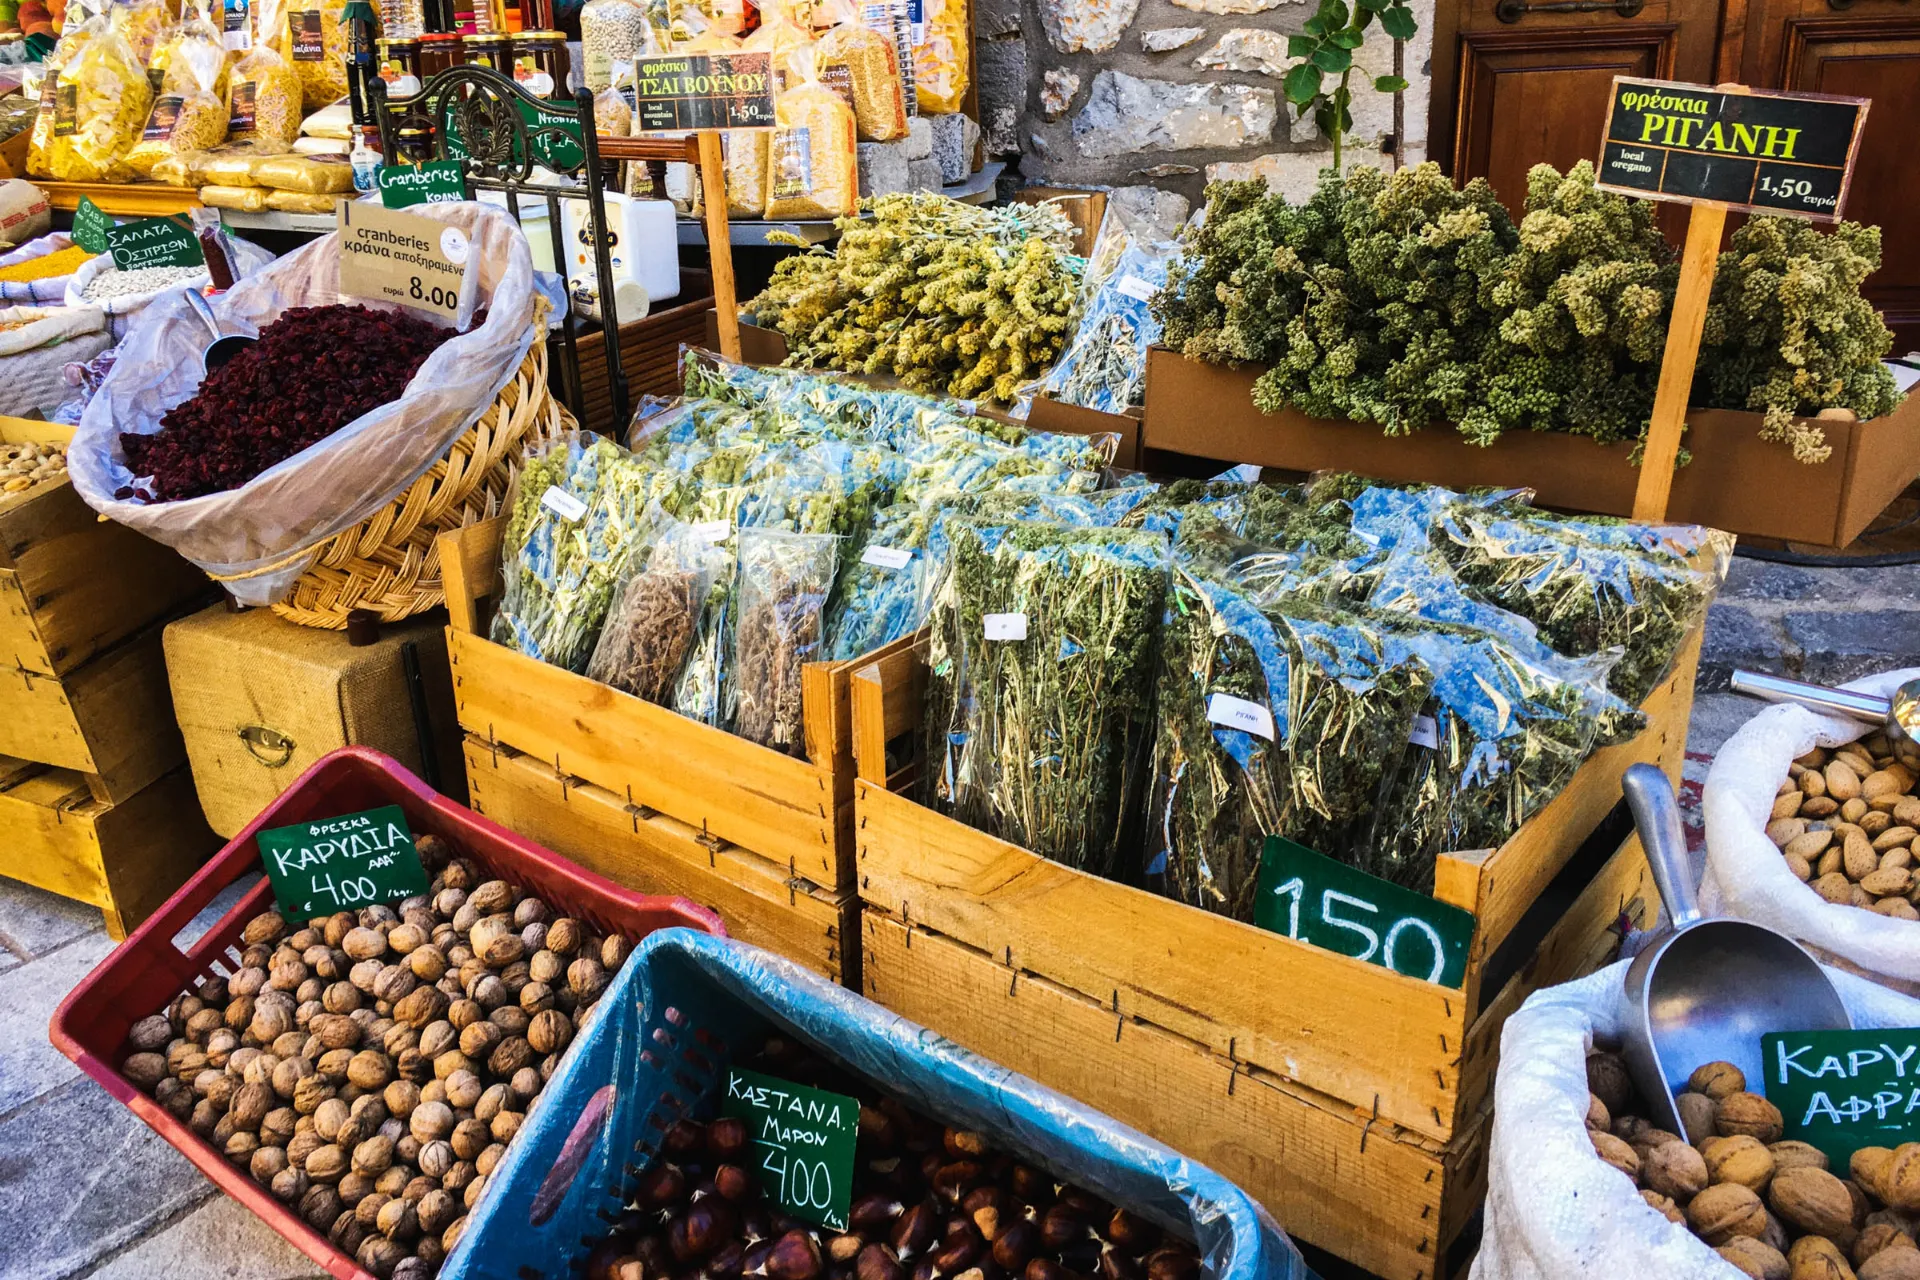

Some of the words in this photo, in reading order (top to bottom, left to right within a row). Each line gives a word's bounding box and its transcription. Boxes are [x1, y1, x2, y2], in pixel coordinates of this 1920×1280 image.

[642, 60, 688, 76] φρέσκο
[639, 77, 680, 95] ΤΣΑΙ
[684, 74, 767, 94] ΒΟΥΝΟΥ
[1621, 89, 1708, 114] φρέσκια
[1639, 113, 1801, 158] ΡΙΓΑΝΗ
[1611, 159, 1651, 173] oregano
[1621, 149, 1644, 161] local
[379, 165, 458, 188] Cranberies
[1760, 176, 1812, 198] 1,50
[1803, 194, 1836, 207] ευρώ
[106, 224, 173, 247] ΣΑΛΑΤΑ
[357, 227, 430, 252] cranberies
[344, 239, 390, 258] κράνα
[409, 276, 458, 310] 8.00
[309, 816, 371, 837] ΦΡΕΣΚΑ
[272, 823, 410, 877] ΚΑΡΥΔΙΑ
[1777, 1040, 1920, 1084] ΚΑΡΥ
[762, 1115, 828, 1146] ΜΑΡΟΝ
